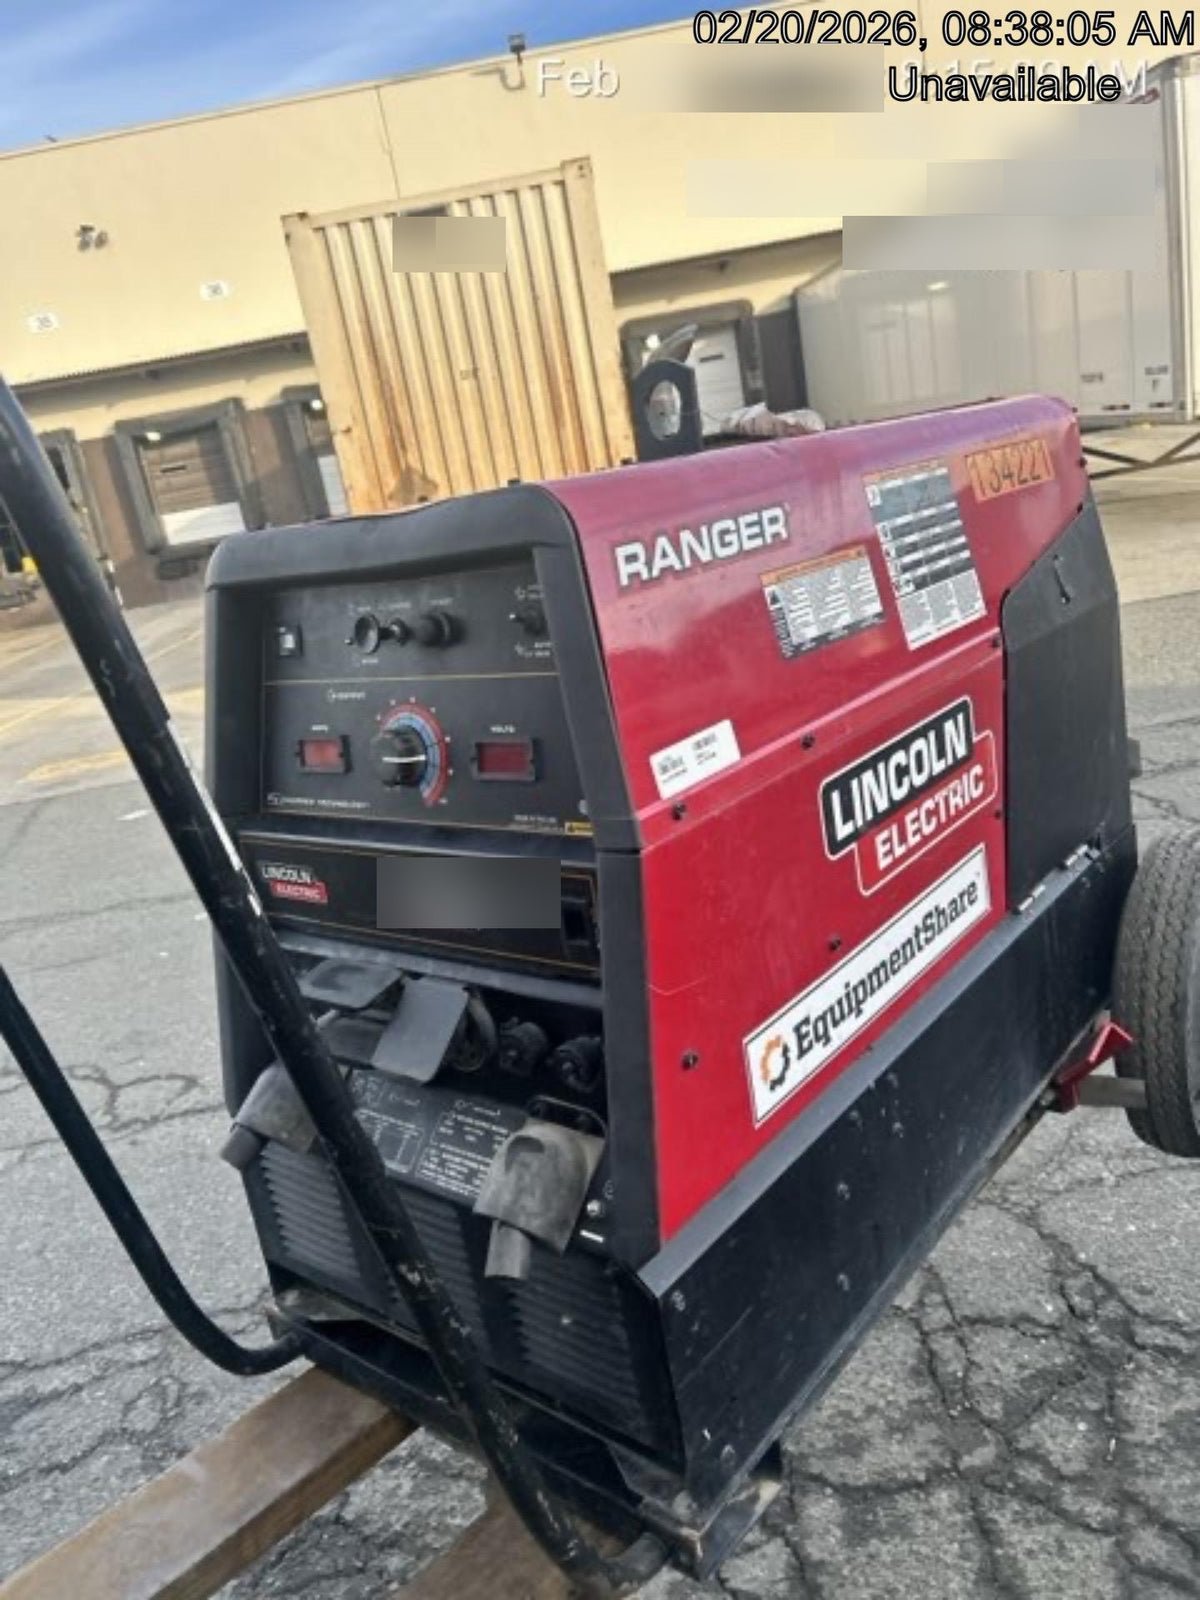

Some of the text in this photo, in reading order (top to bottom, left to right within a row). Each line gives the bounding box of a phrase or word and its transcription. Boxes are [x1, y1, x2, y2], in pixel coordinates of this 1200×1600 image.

[614, 505, 789, 587] RANGER
[831, 711, 968, 842] LINCOLN
[874, 763, 985, 872] ELECTRIC
[791, 880, 979, 1062] EquipmentShare
